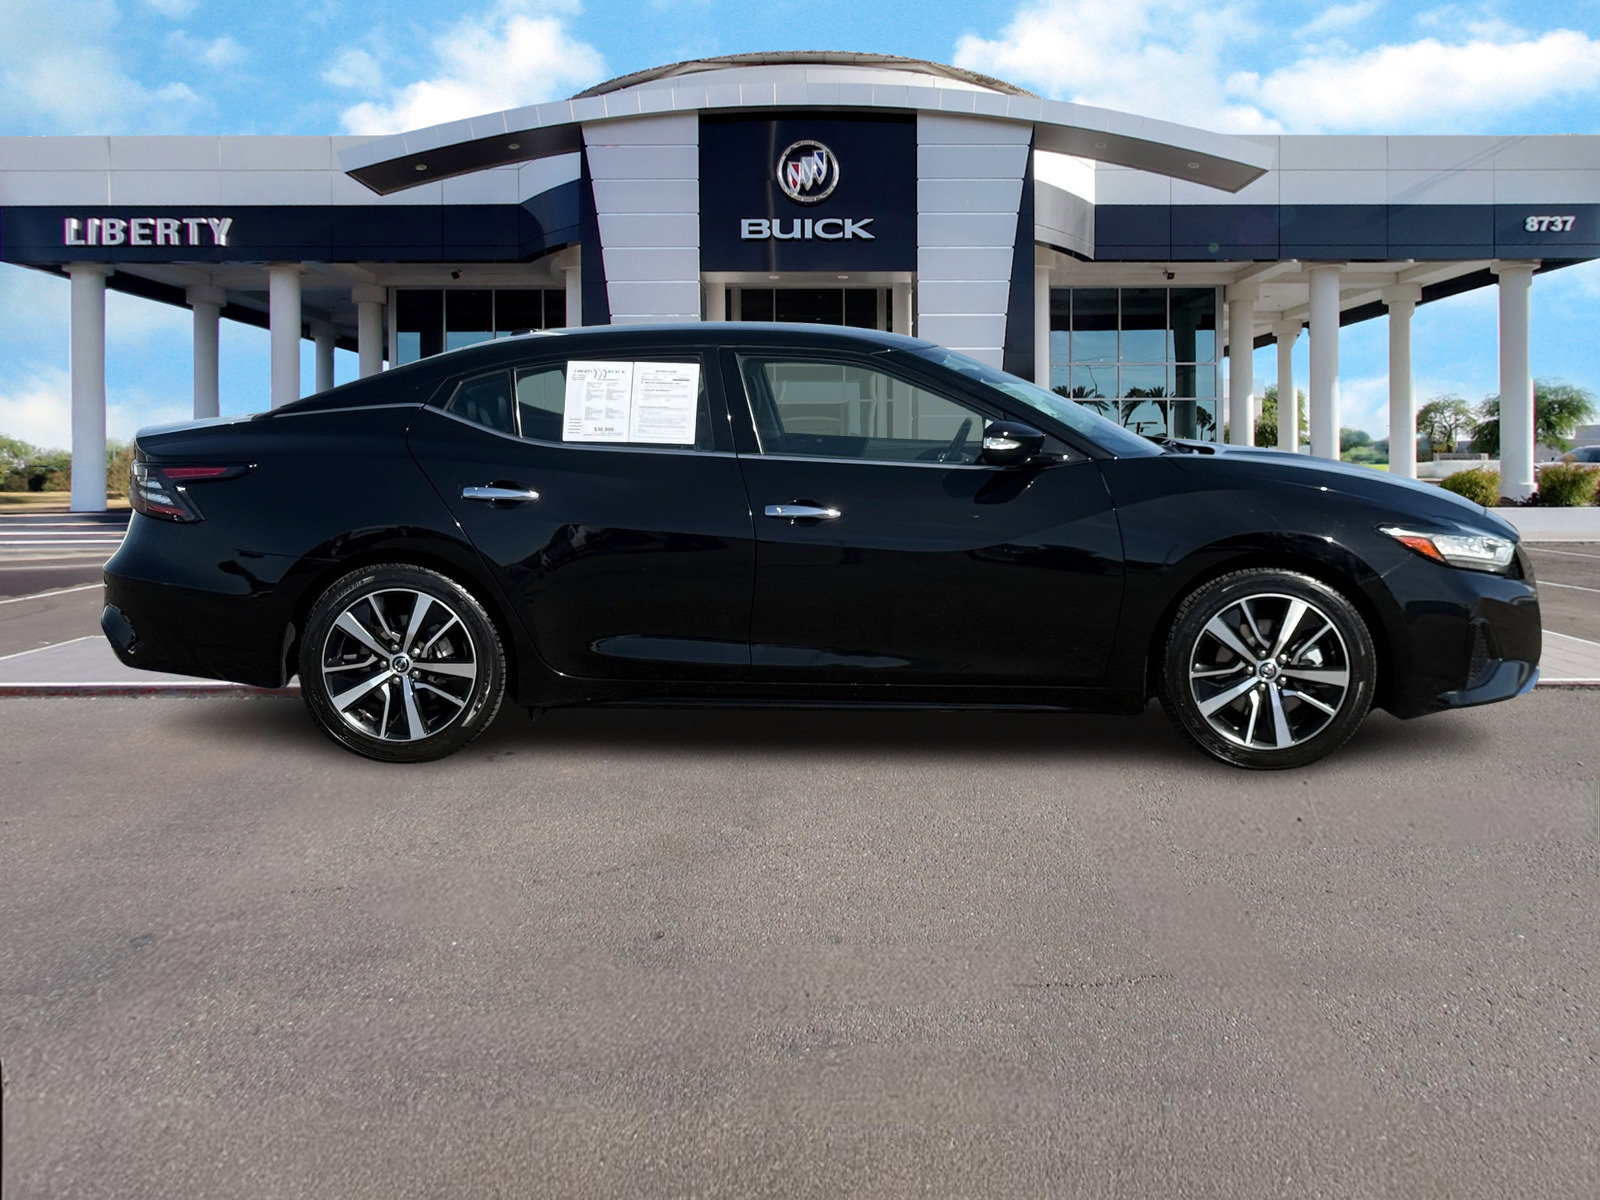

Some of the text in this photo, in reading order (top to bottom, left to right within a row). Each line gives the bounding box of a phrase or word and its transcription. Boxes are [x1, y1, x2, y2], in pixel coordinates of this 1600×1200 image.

[64, 217, 233, 246] LIBERTY
[740, 218, 876, 239] BUICK
[1525, 215, 1576, 232] 8737
